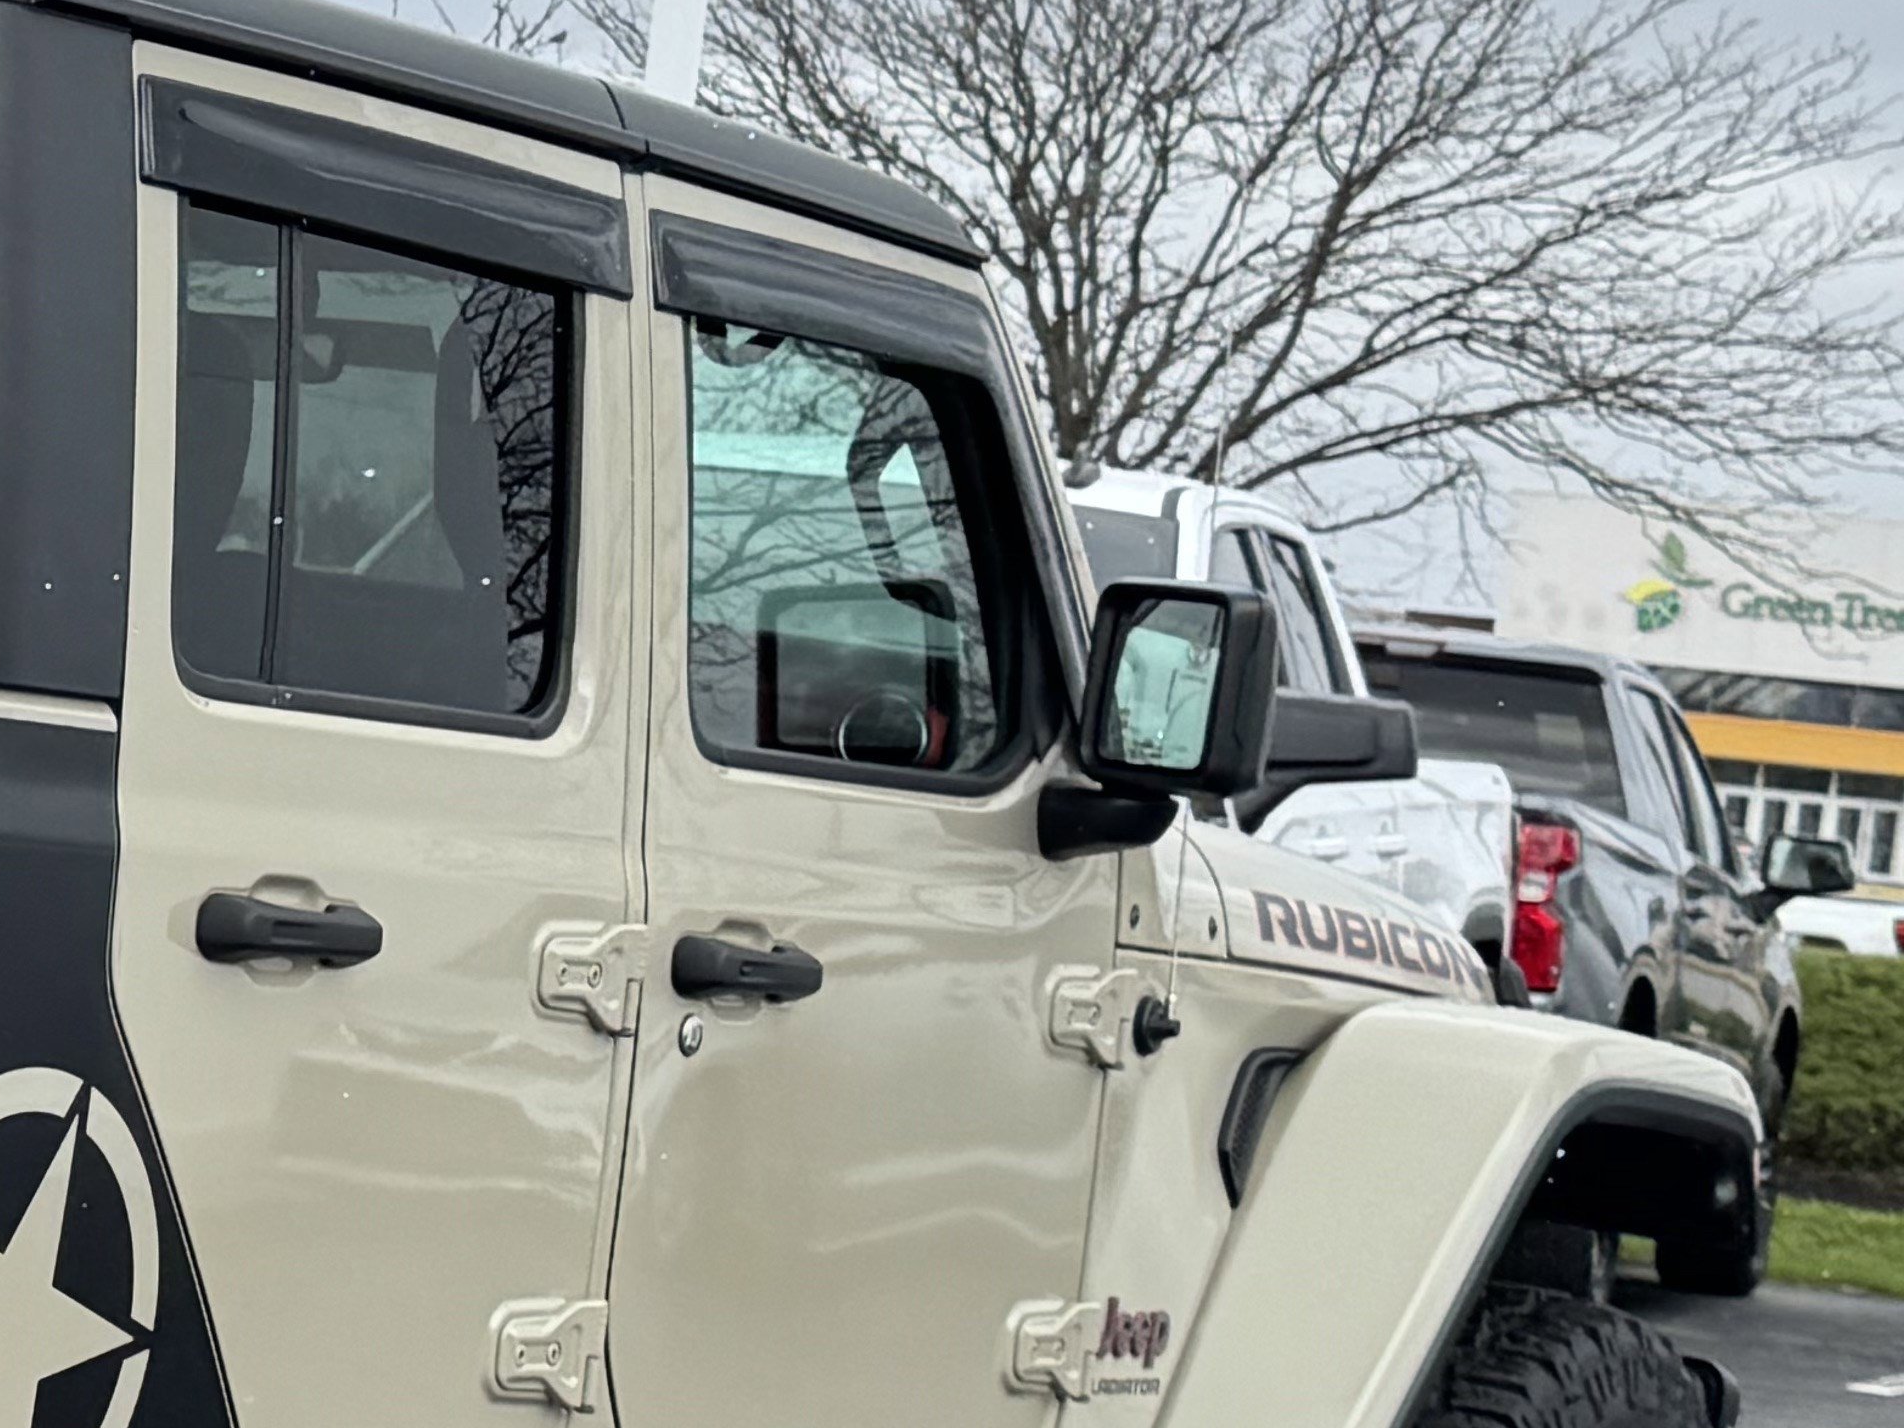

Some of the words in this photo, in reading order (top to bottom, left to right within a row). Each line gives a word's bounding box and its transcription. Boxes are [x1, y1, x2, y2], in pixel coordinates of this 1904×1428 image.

[1720, 581, 1833, 628] Green
[1253, 888, 1485, 990] RUBICON
[1095, 1295, 1171, 1370] Jeep
[1090, 1377, 1161, 1396] LADIATOR
